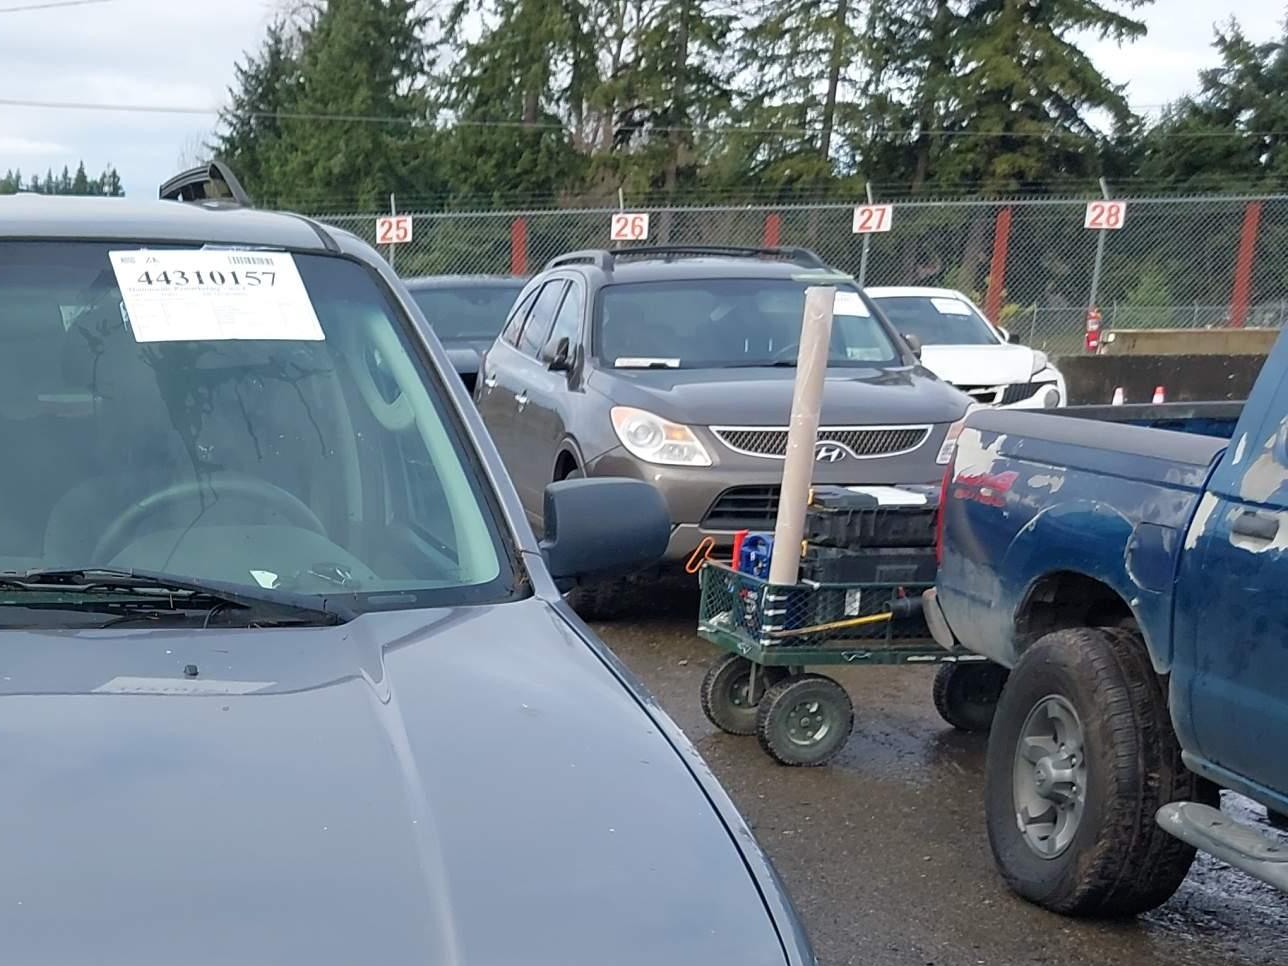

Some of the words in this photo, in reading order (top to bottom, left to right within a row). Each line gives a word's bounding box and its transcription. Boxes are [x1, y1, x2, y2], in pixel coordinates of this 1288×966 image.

[615, 216, 644, 239] 26
[859, 207, 886, 232] 27
[1089, 203, 1120, 228] 28
[379, 219, 409, 243] 25
[137, 269, 276, 287] 44310157
